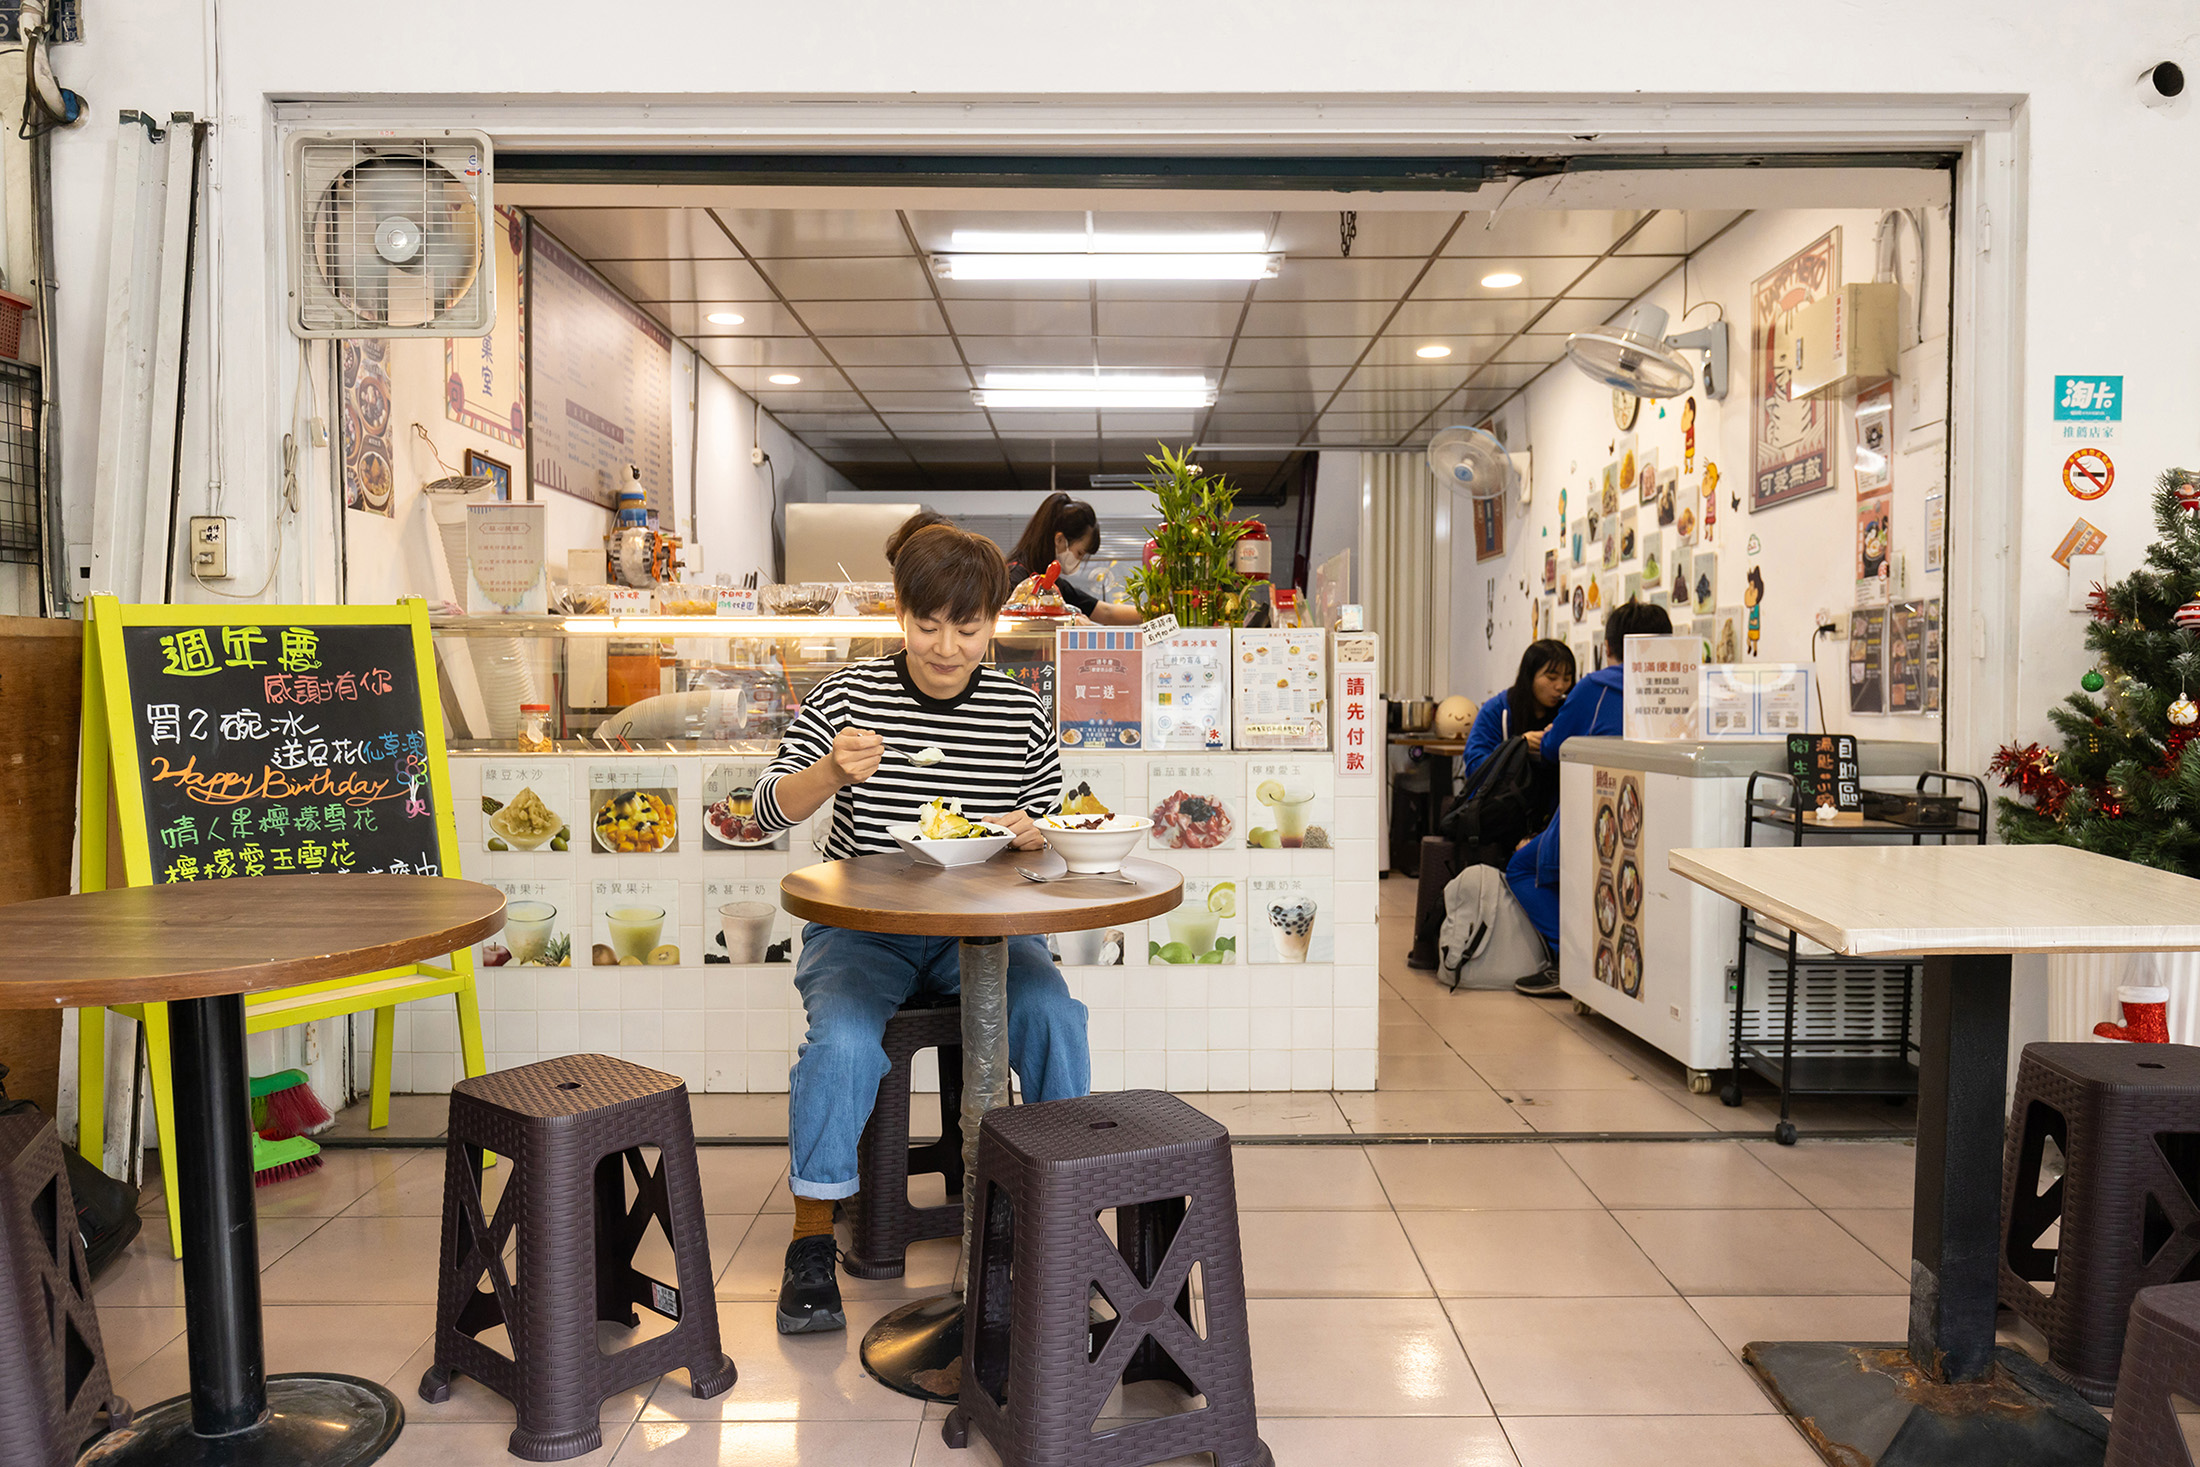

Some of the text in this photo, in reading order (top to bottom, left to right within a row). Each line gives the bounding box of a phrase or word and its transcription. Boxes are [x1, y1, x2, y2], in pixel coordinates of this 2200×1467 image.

[2061, 379, 2115, 410] 淘卡
[1759, 456, 1822, 496] 可愛無敵
[160, 627, 322, 676] 週年慶
[264, 667, 393, 705] 感謝有你
[1074, 685, 1130, 700] 買二送一
[1346, 677, 1365, 770] 請先付款
[151, 755, 390, 806] Happy Birthday
[485, 769, 544, 781] 綠豆冰沙
[594, 773, 643, 784] 芒果丁丁
[1838, 738, 1858, 806] 自助區
[596, 883, 653, 895] 奇異果汁
